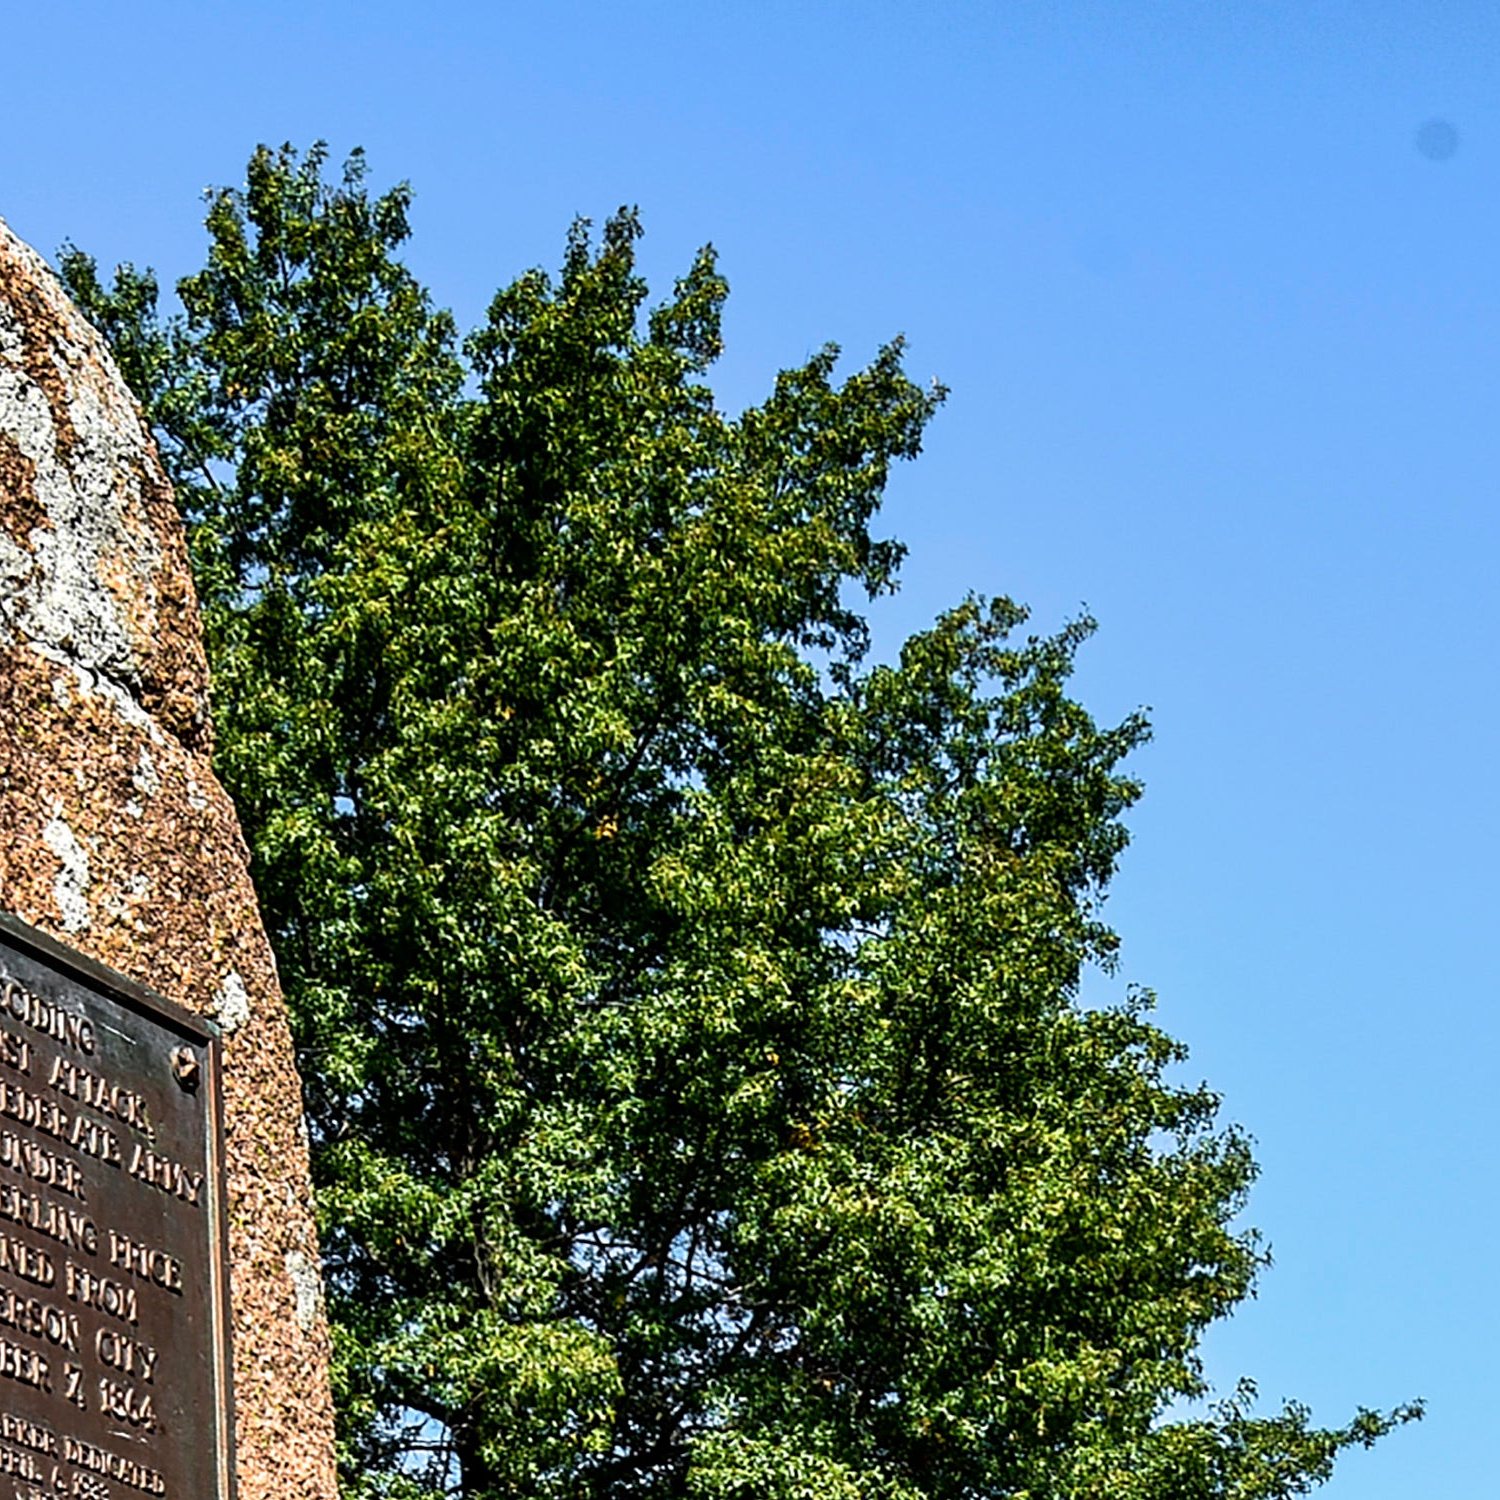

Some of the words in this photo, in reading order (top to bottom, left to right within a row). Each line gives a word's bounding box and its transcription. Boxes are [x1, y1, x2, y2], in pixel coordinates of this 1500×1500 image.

[129, 1145, 203, 1206] ARMY
[109, 1229, 183, 1297] PRICE
[66, 1261, 138, 1326] FROM
[96, 1328, 158, 1384] CITY
[64, 1363, 87, 1410] 7,
[64, 1436, 165, 1496] DEDICATED
